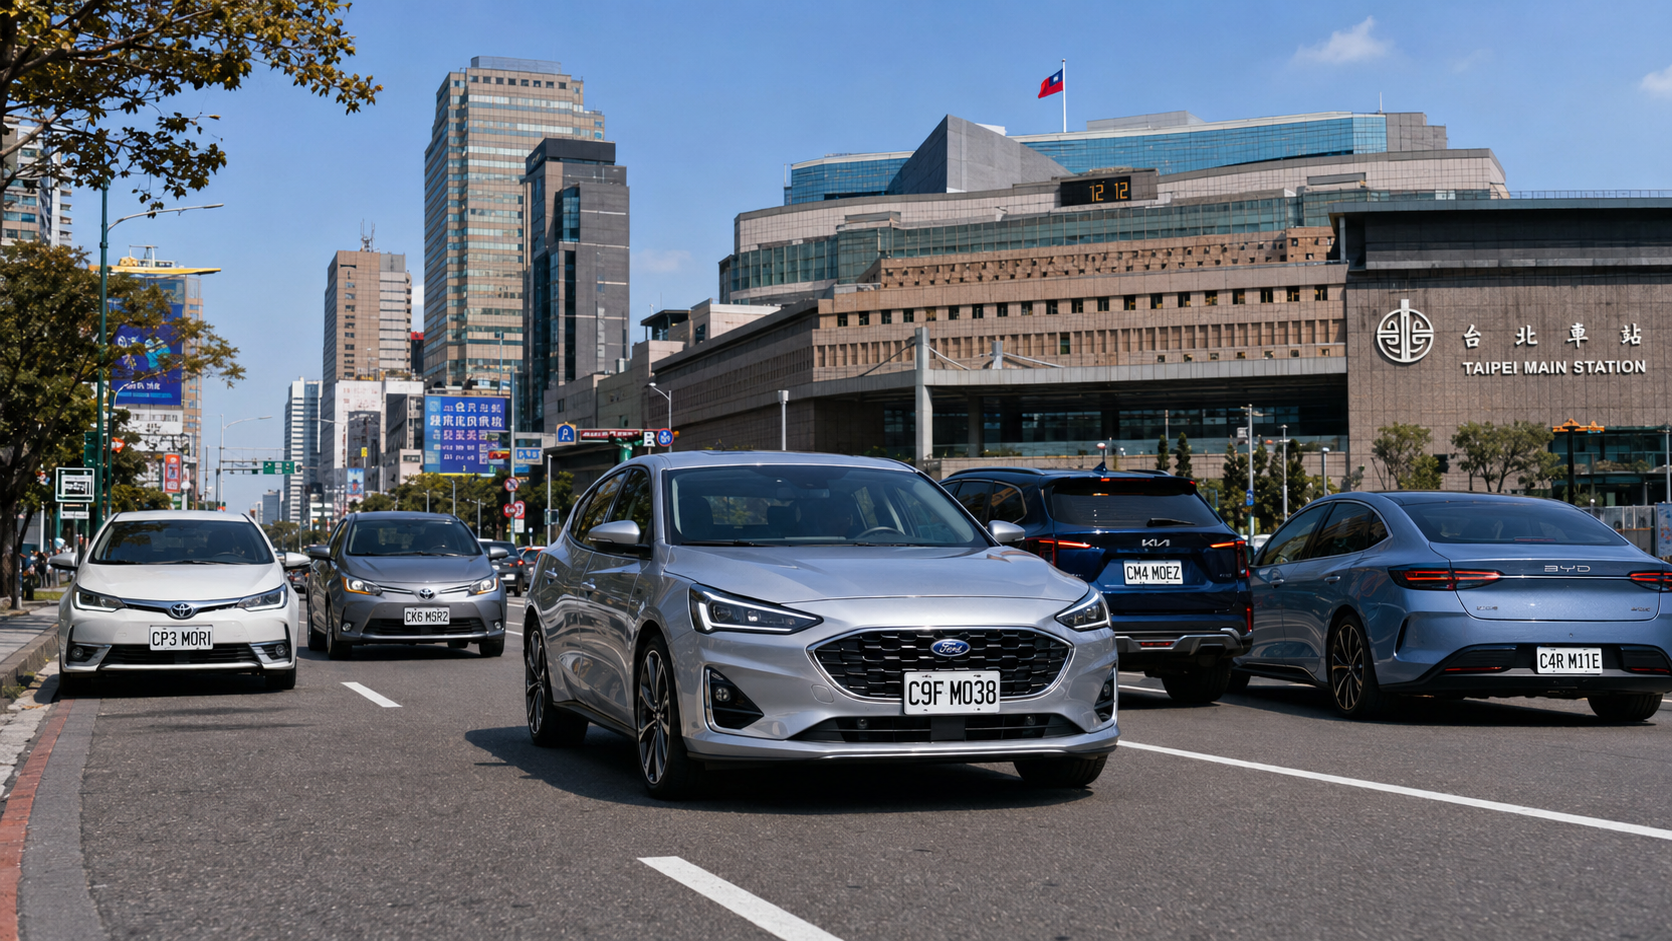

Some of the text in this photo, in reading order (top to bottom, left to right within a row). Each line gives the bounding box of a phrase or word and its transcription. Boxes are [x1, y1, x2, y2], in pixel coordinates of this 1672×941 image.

[1089, 181, 1128, 202] 12 12
[1463, 322, 1642, 348] 台北車站
[1463, 360, 1646, 375] TAIPEI MAIN STATION
[1141, 539, 1170, 547] KIA
[1126, 566, 1149, 580] CM4
[1544, 565, 1591, 573] BYD
[405, 611, 423, 622] CK6
[152, 631, 177, 646] CP3
[939, 641, 963, 653] Ford
[1540, 653, 1600, 669] C4R M11E
[908, 680, 944, 705] C9F
